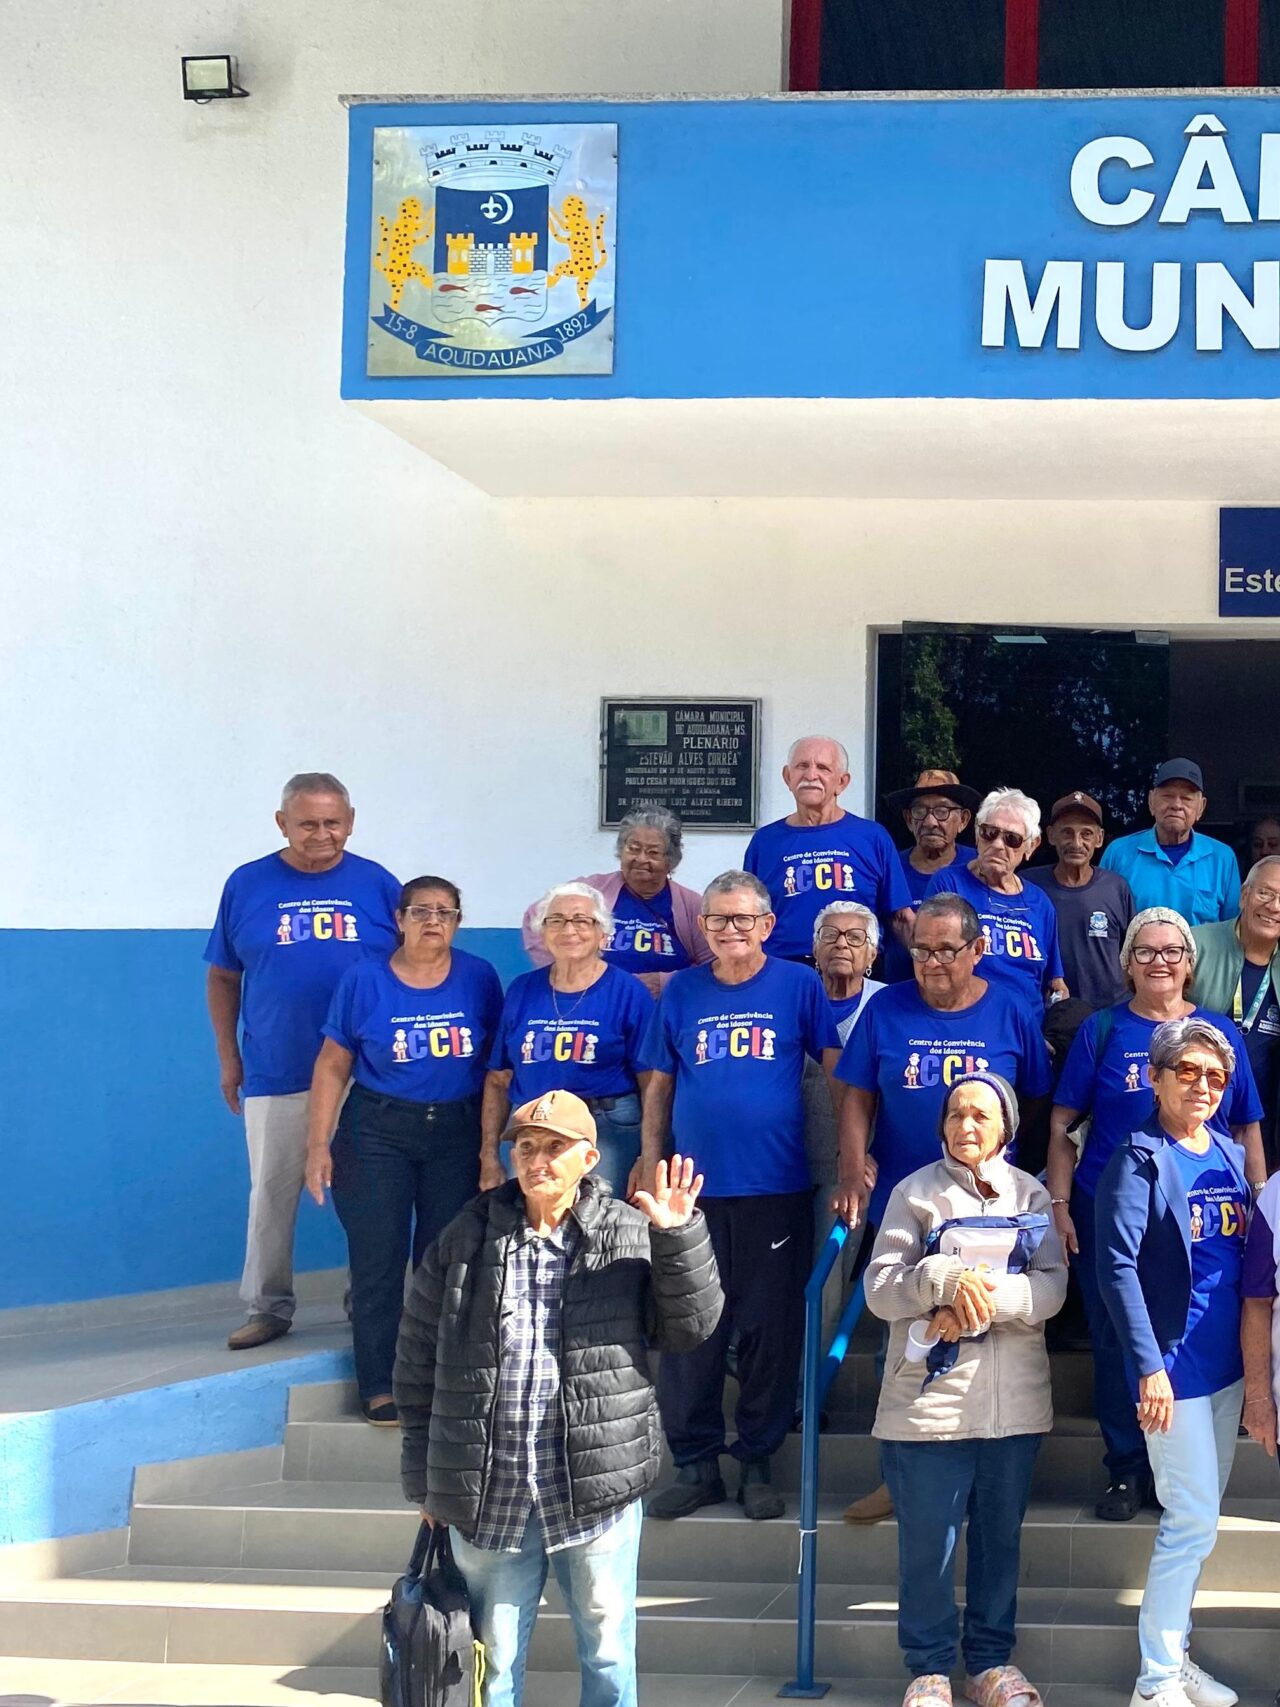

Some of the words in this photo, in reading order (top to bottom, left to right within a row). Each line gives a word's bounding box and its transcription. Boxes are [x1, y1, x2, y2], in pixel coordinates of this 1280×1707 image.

[384, 311, 419, 341] 15-8
[555, 311, 593, 343] 1892
[423, 340, 558, 368] AQUIDAUANA
[683, 736, 739, 749] PLENÁRIO
[678, 751, 704, 766] ALVES
[796, 862, 842, 892] CCI
[292, 912, 344, 941] CCI
[614, 929, 662, 953] CCI
[991, 927, 1032, 958] CCI
[407, 1026, 461, 1060] CCI
[533, 1031, 585, 1062] CCI
[708, 1026, 761, 1060] CCI
[908, 1038, 933, 1046] Centro
[932, 1039, 942, 1047] de
[942, 1039, 986, 1048] Convivência
[929, 1047, 942, 1055] dos
[943, 1047, 966, 1055] Idosos
[1123, 1051, 1149, 1059] Centro
[1203, 1202, 1246, 1238] CCI
